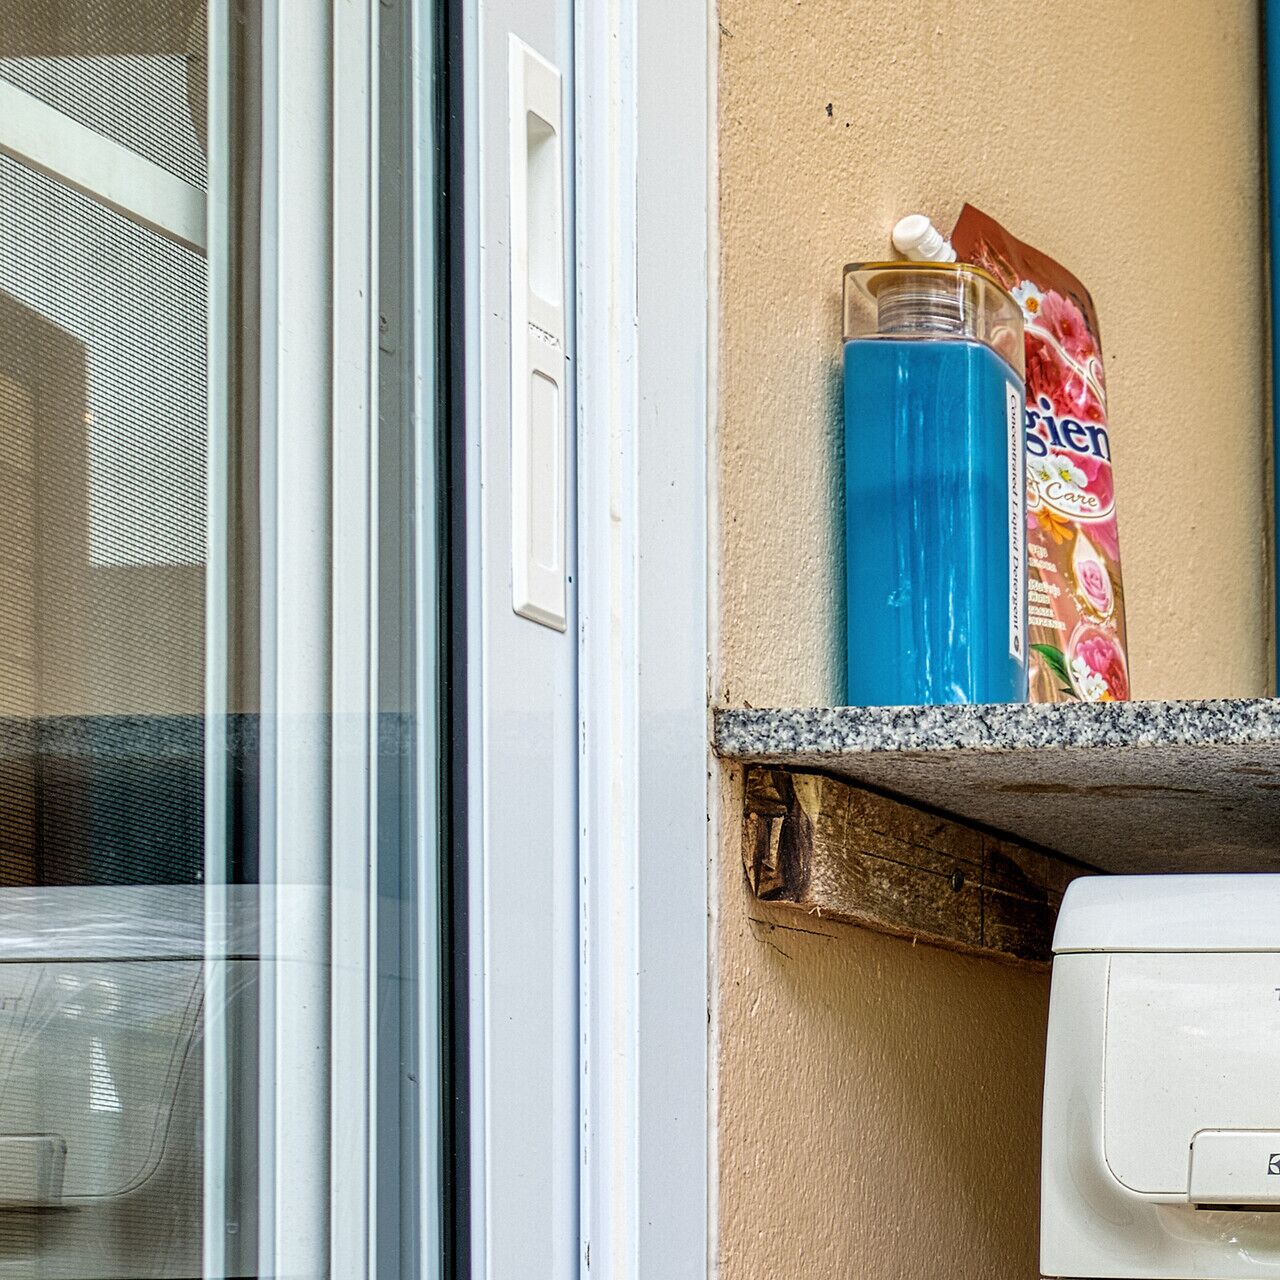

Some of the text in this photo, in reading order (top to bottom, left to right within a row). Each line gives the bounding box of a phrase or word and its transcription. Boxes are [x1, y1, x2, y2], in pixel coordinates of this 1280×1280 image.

[1010, 394, 1019, 631] Concentrated Liquid Detergent
[1046, 481, 1098, 507] Care
